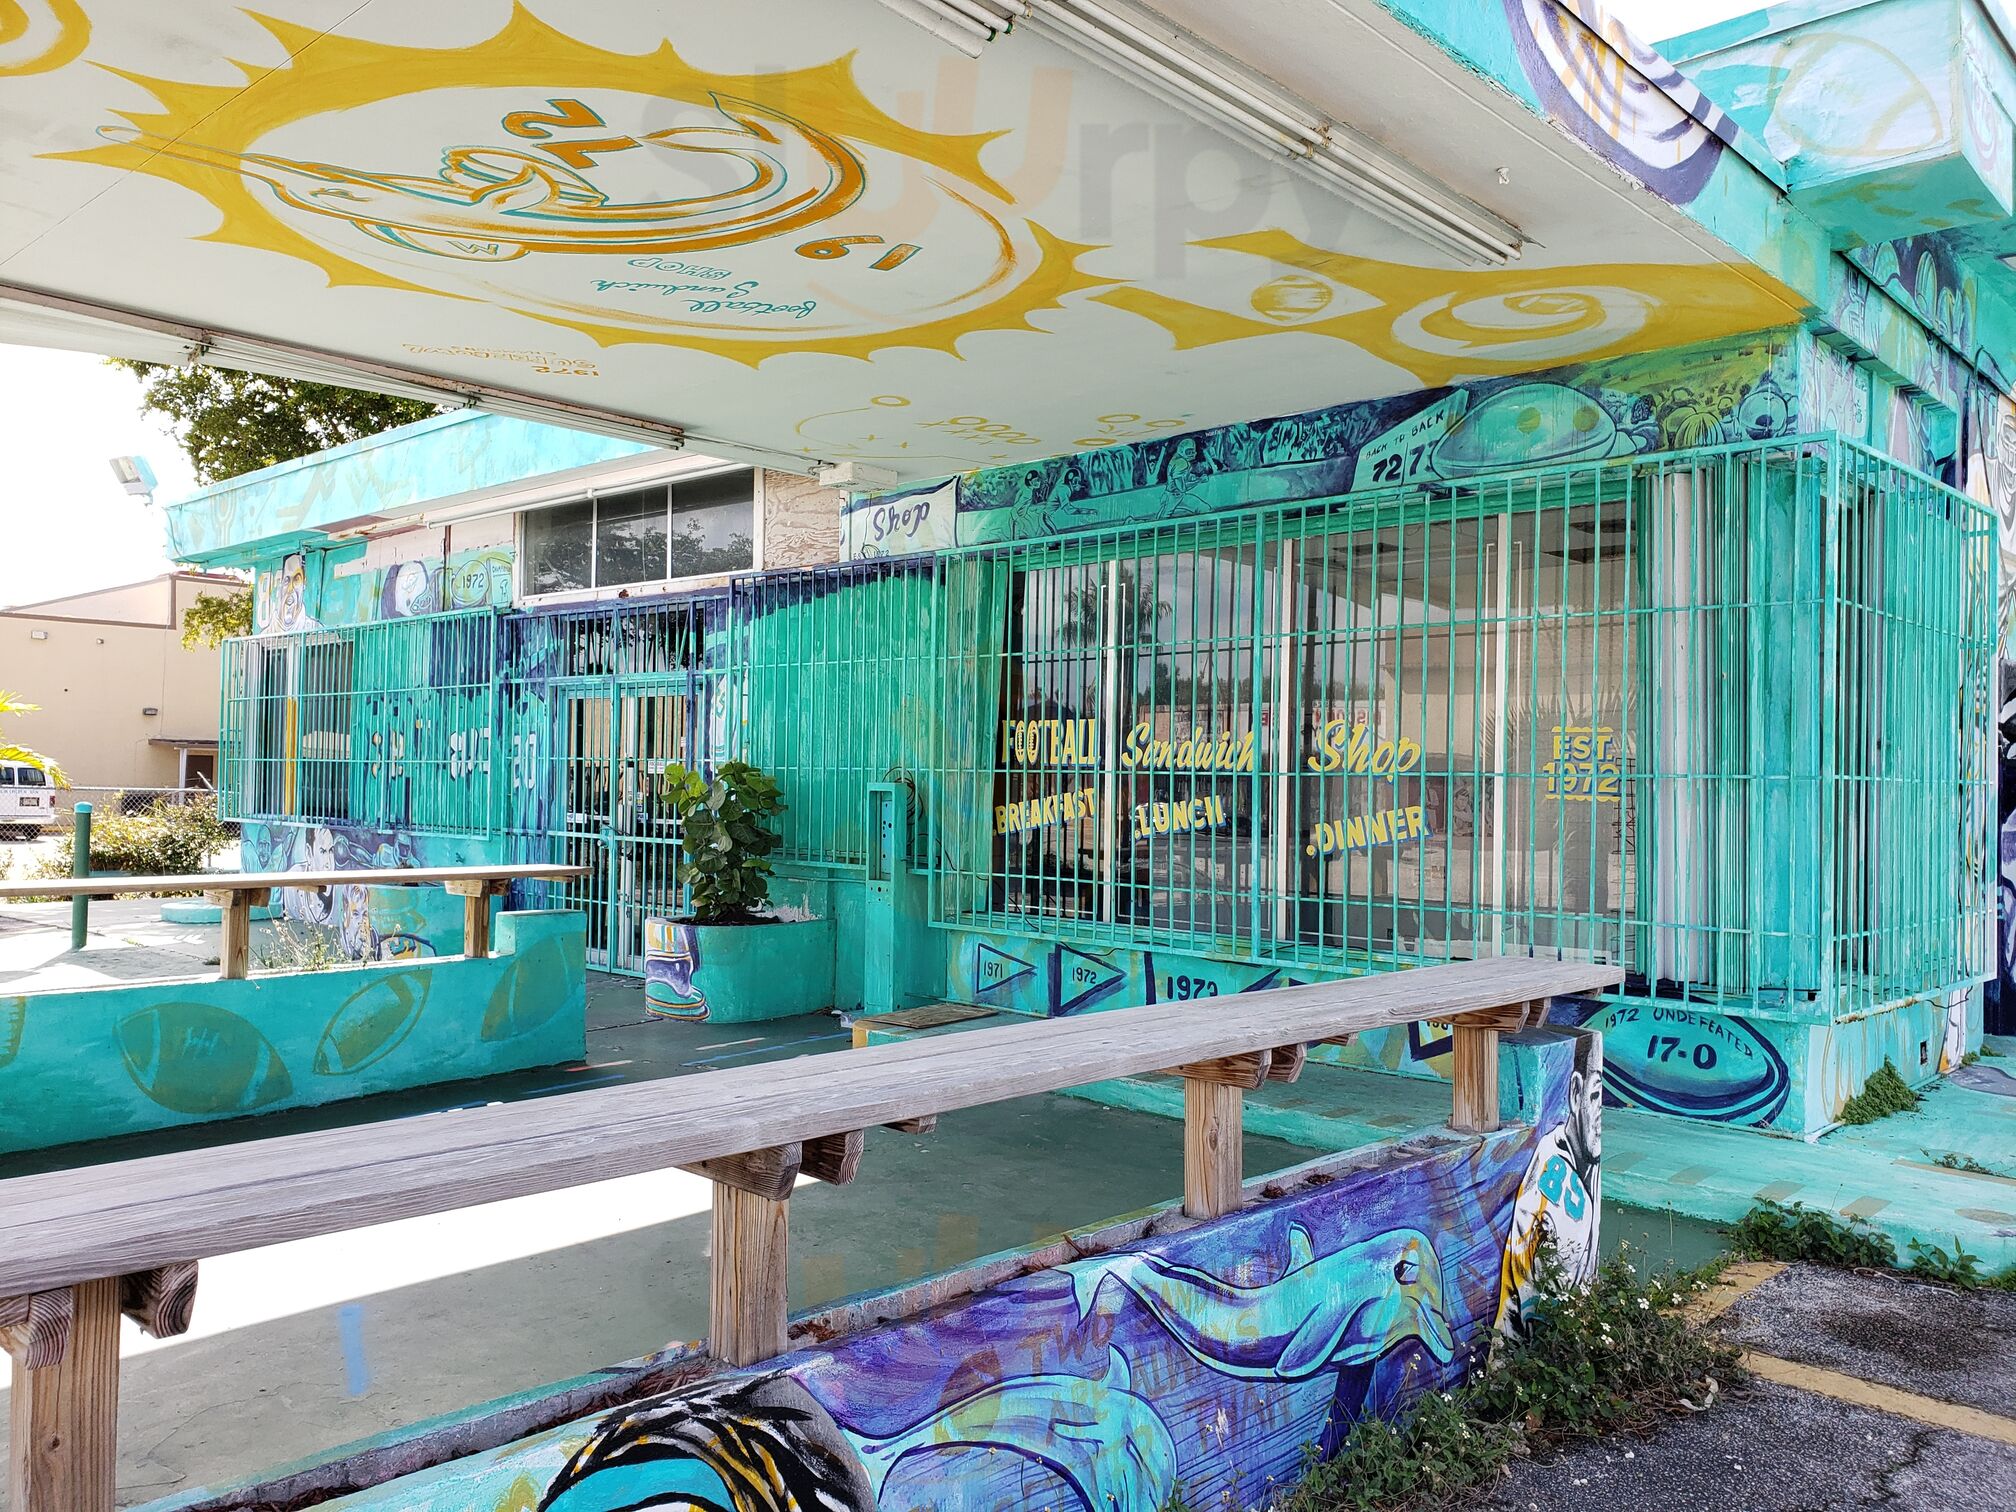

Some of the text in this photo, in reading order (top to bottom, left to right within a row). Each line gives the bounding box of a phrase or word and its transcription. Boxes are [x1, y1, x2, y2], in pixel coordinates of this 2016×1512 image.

[1365, 443, 1388, 459] BACK
[1411, 409, 1445, 437] BACK
[872, 501, 931, 542] Shop
[461, 572, 486, 589] 1972
[1001, 718, 1101, 767] FOOTBALL
[1120, 721, 1257, 773] Sandwich
[1307, 718, 1422, 785] Shop
[1542, 761, 1621, 797] 1972
[983, 961, 1003, 979] 1971
[1071, 966, 1098, 985] 1972
[1605, 1006, 1754, 1061] 1972 UNDEFEATED
[1647, 1034, 1718, 1070] 17-0
